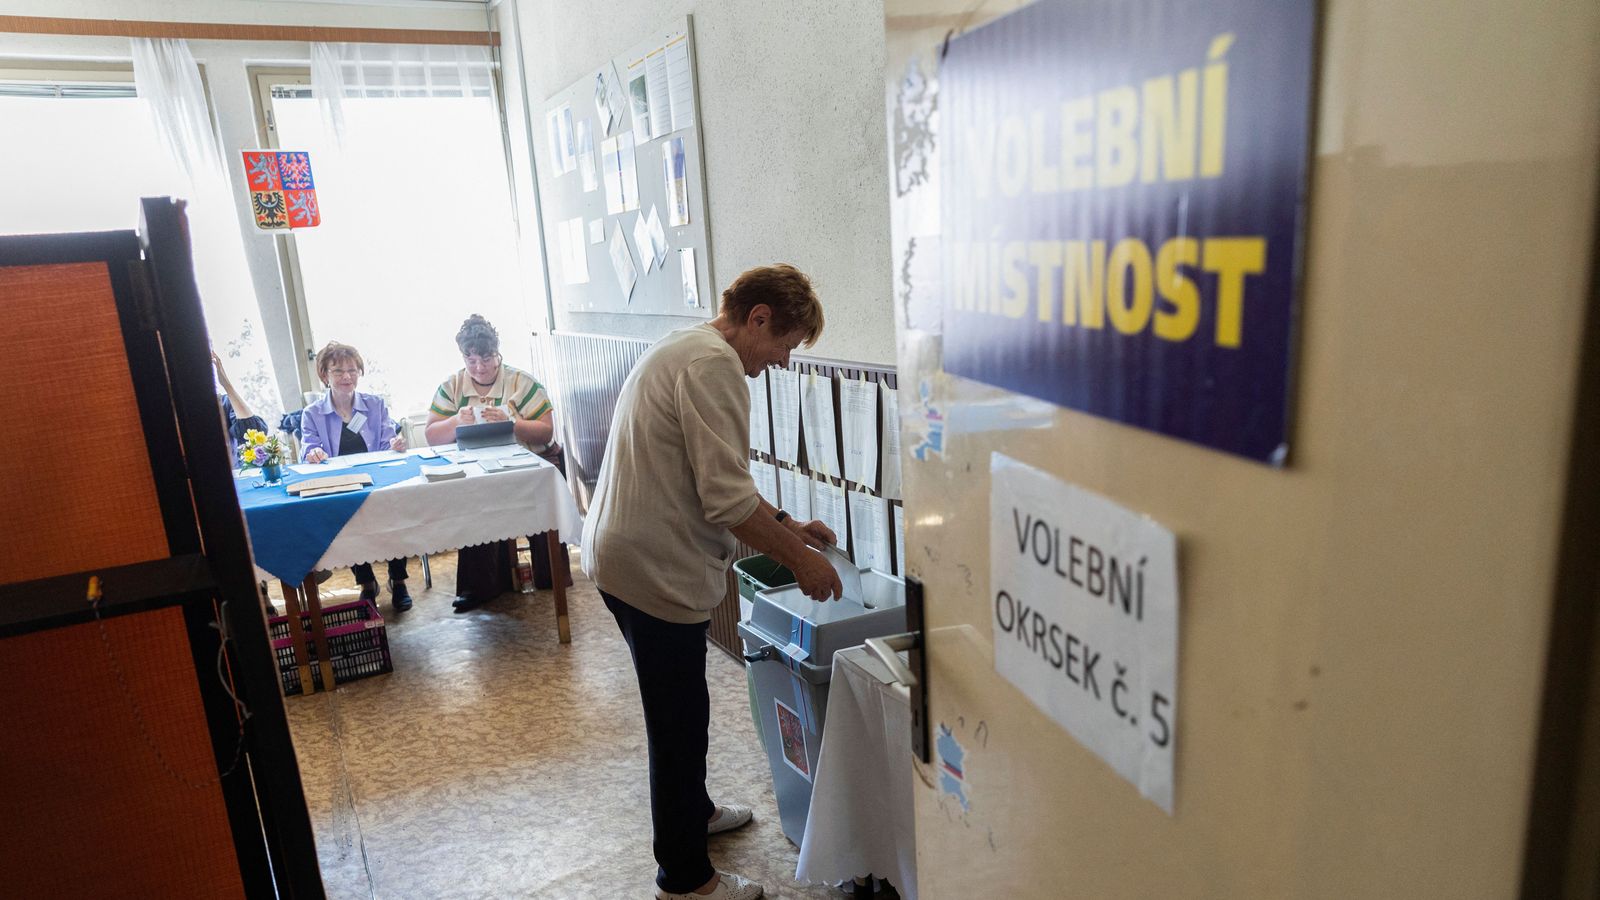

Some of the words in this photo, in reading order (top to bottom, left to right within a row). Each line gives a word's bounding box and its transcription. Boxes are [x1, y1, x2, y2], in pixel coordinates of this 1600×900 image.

[964, 34, 1234, 199] VOLEBNÍ
[953, 228, 1266, 348] MÍSTNOST
[1013, 508, 1147, 621] VOLEBNÍ
[996, 590, 1101, 700] OKRSEK
[1150, 692, 1169, 747] 5
